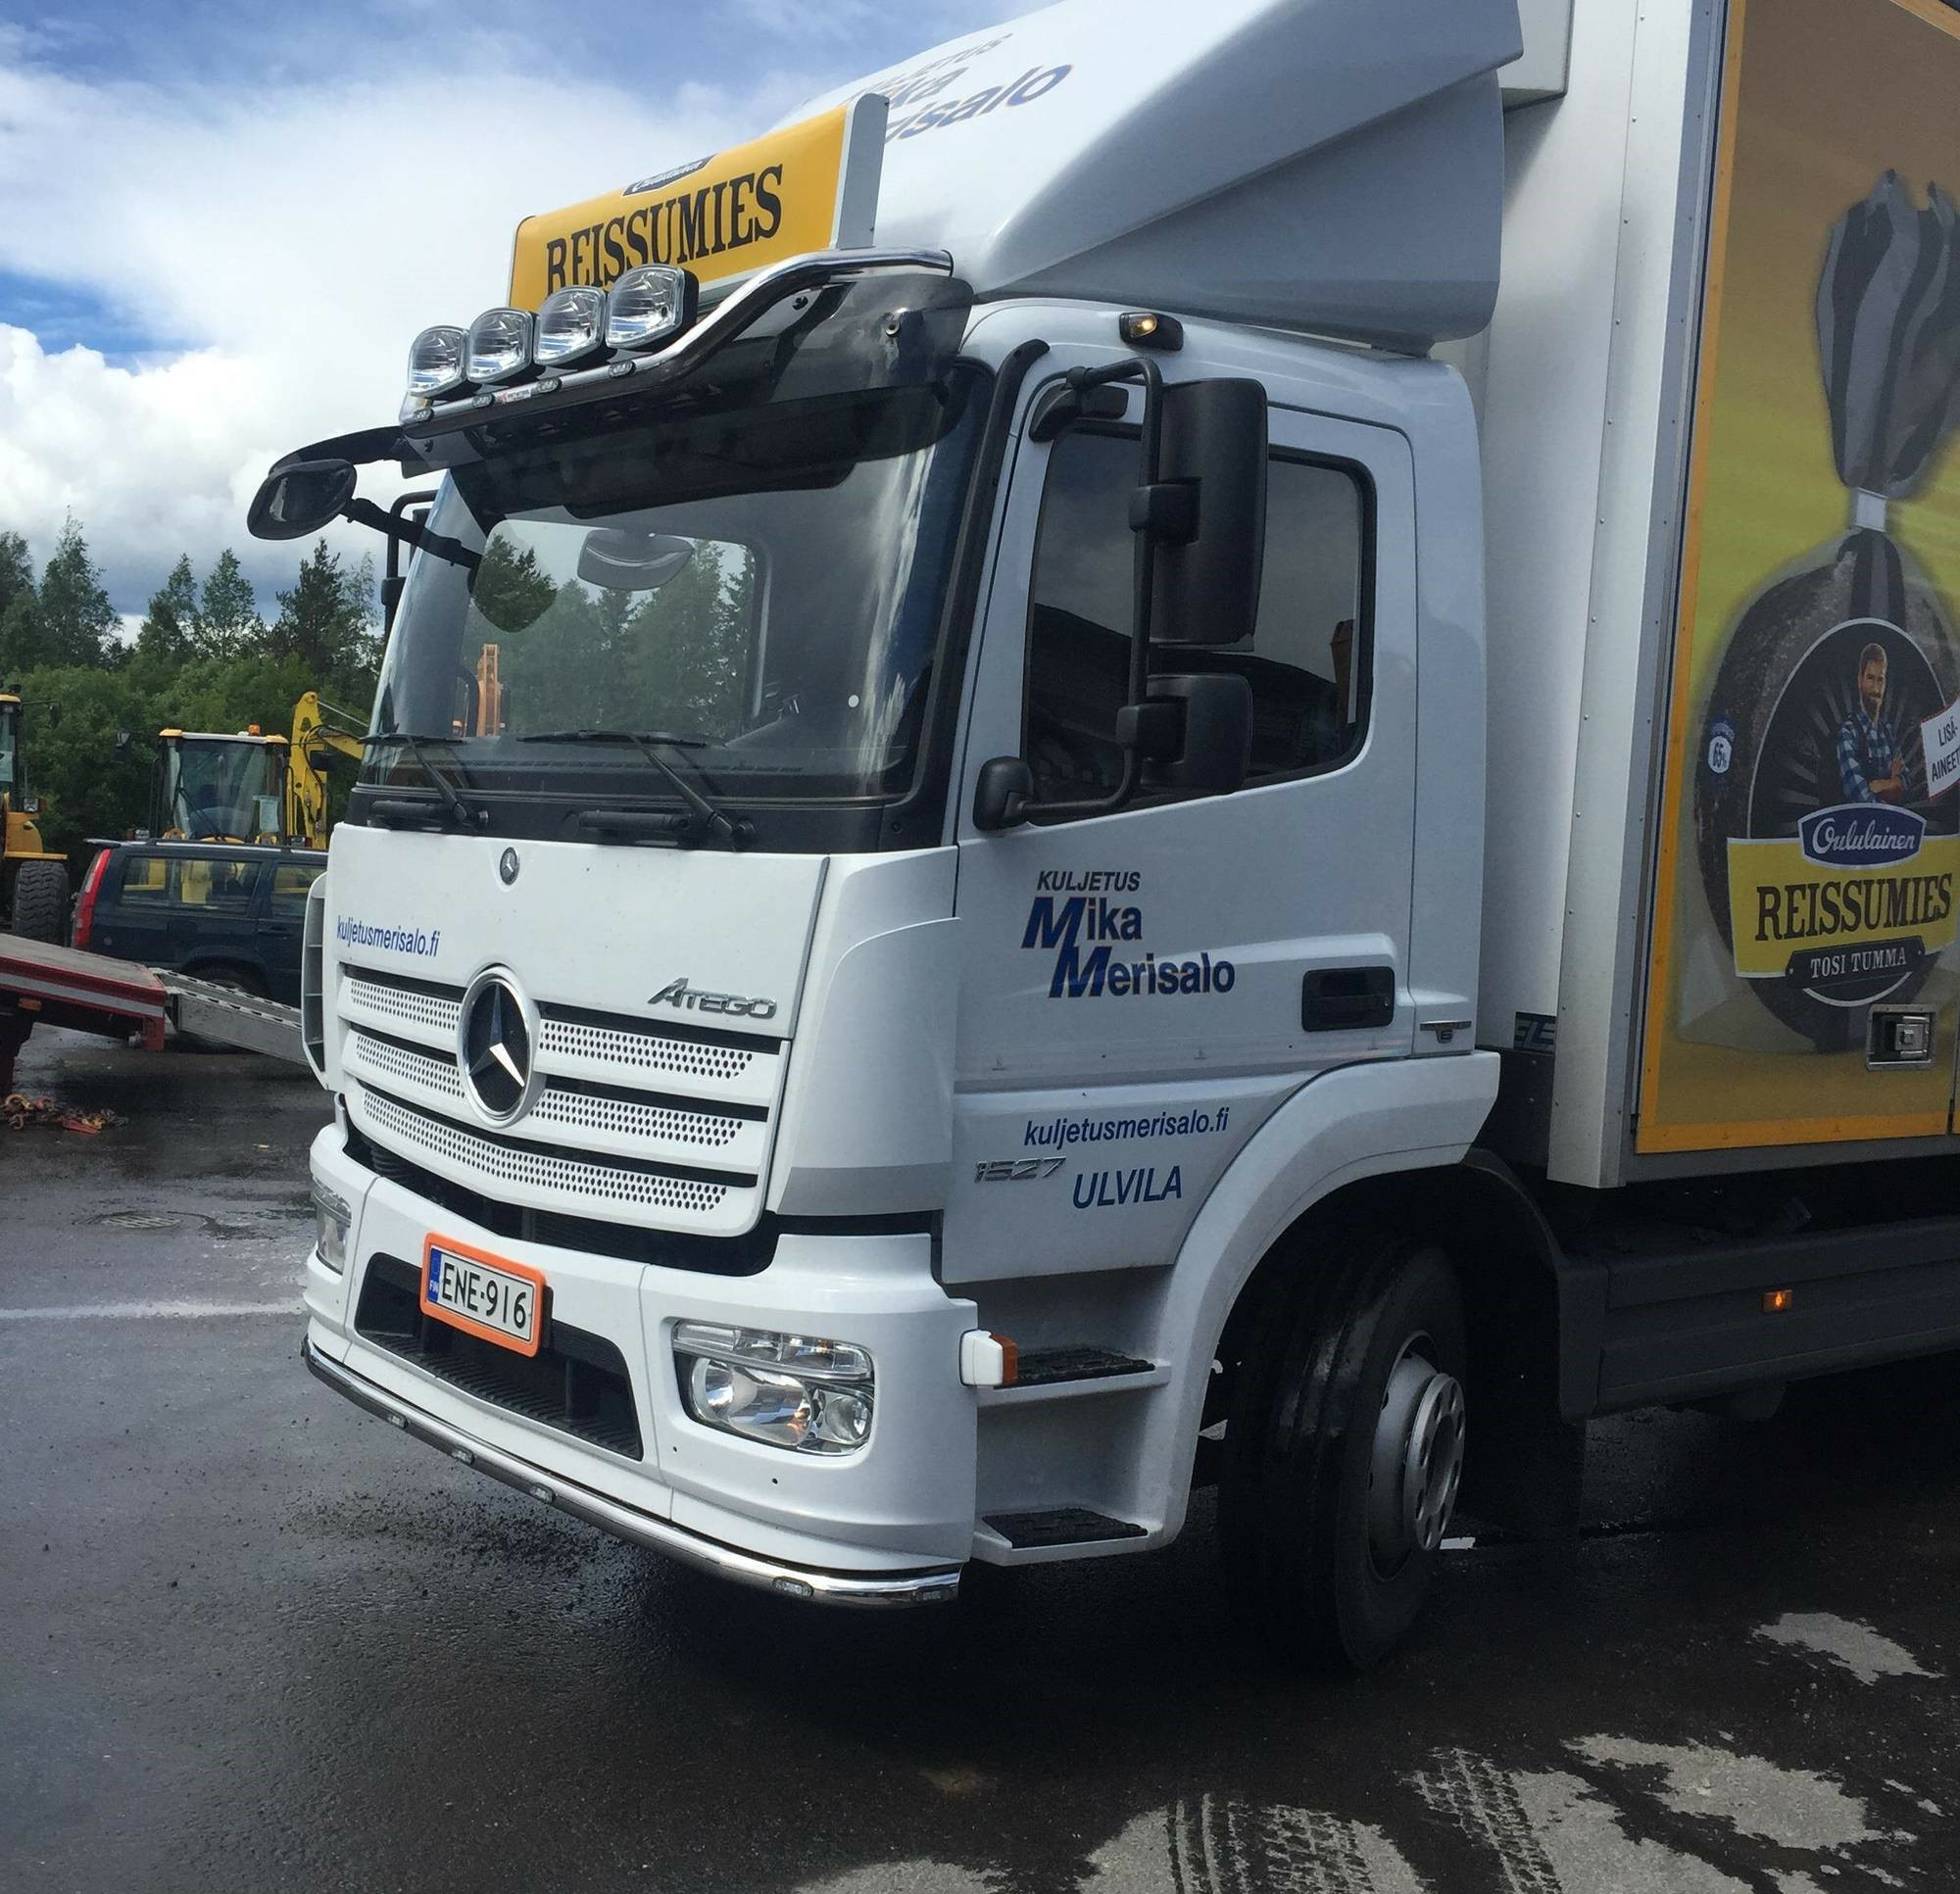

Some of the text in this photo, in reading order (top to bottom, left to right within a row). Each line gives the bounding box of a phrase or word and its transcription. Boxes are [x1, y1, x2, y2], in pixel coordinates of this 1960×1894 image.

[547, 165, 782, 293] REISSUMIES
[1938, 716, 1959, 747] LISÄ-
[1813, 817, 1915, 853] Oululainen
[1037, 870, 1141, 891] KULJETUS
[1021, 897, 1143, 948] Mika
[1755, 873, 1952, 941] REISSUMIES
[337, 916, 440, 956] kuljetusmerisalo.fi
[1049, 946, 1236, 998] Merisalo
[1810, 947, 1907, 979] TOSI TUMMA
[648, 977, 777, 1019] ATEGO
[1023, 1106, 1230, 1150] kuljetusmerisalo.fi
[974, 1155, 1066, 1183] 1527
[1072, 1165, 1182, 1209] ULVILA
[442, 1262, 526, 1329] ENE-916
